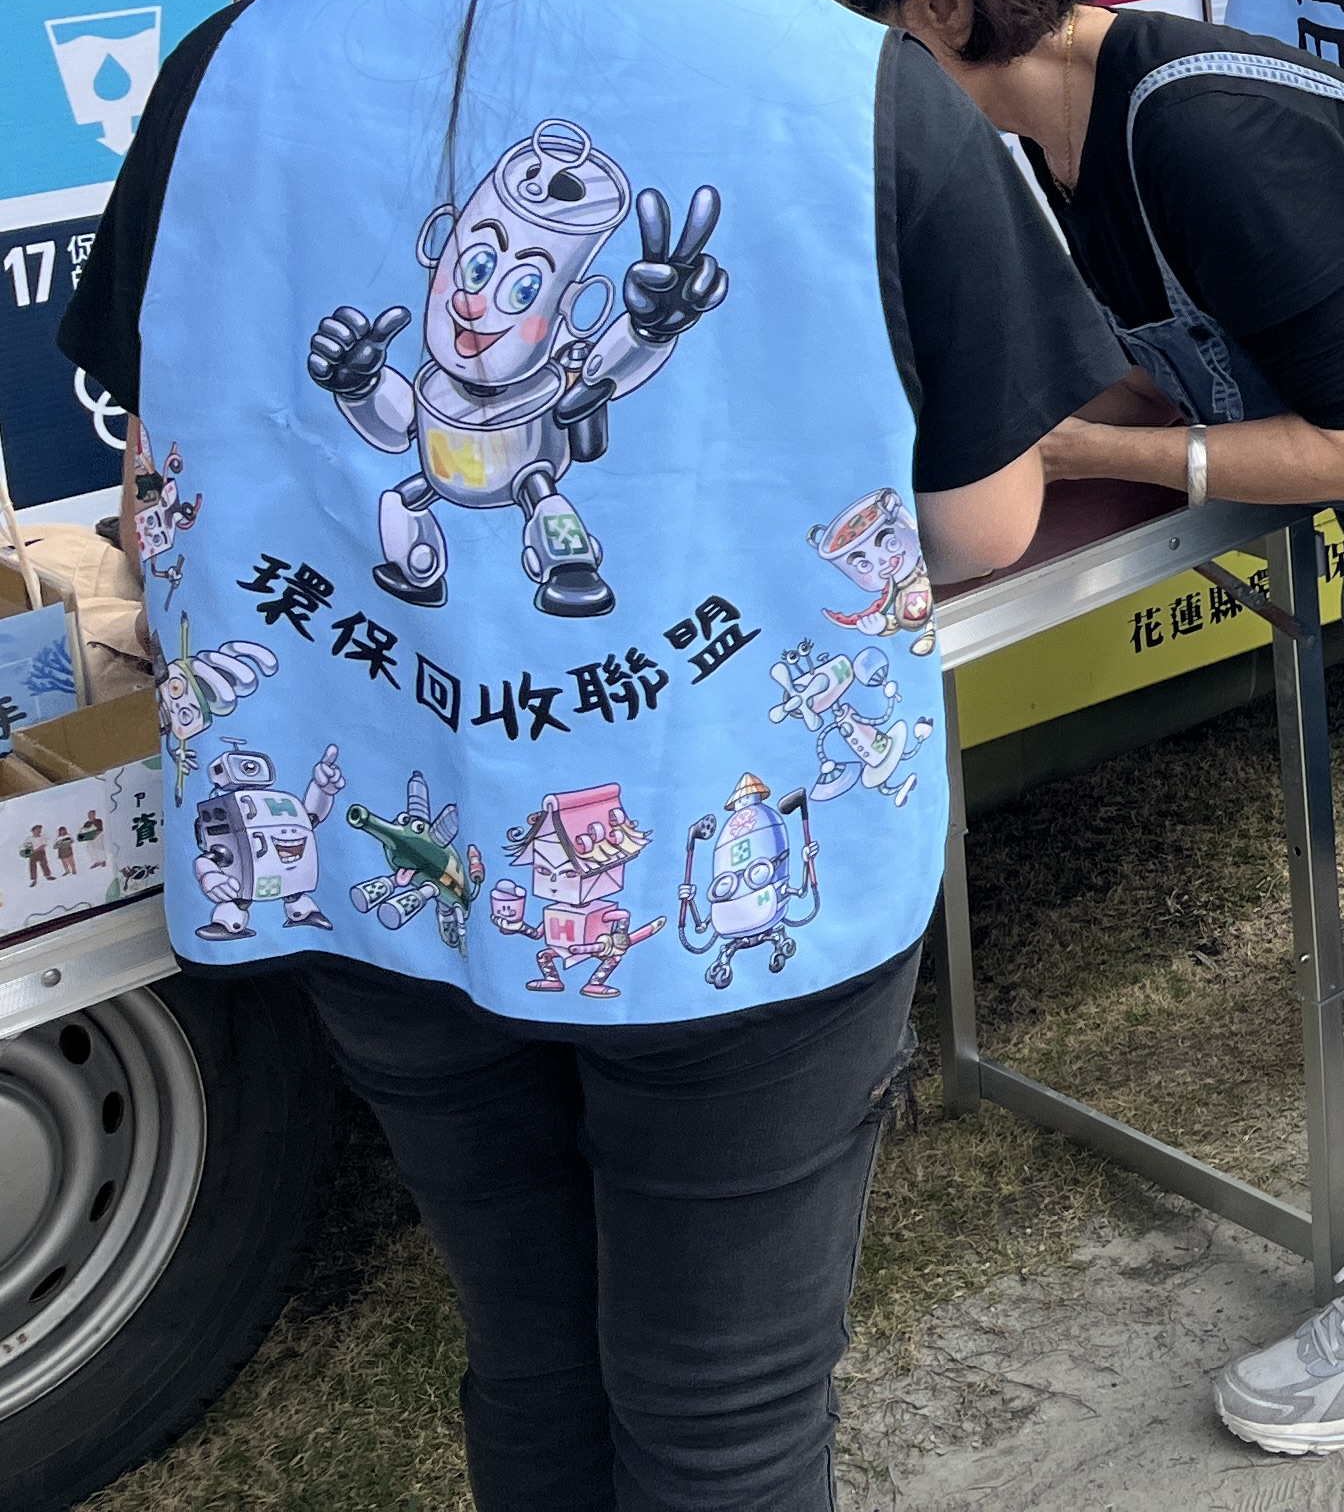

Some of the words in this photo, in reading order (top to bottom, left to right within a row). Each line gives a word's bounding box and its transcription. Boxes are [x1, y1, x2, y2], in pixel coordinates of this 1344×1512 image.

[3, 240, 56, 307] 17
[237, 552, 763, 741] 環保回收聯盟
